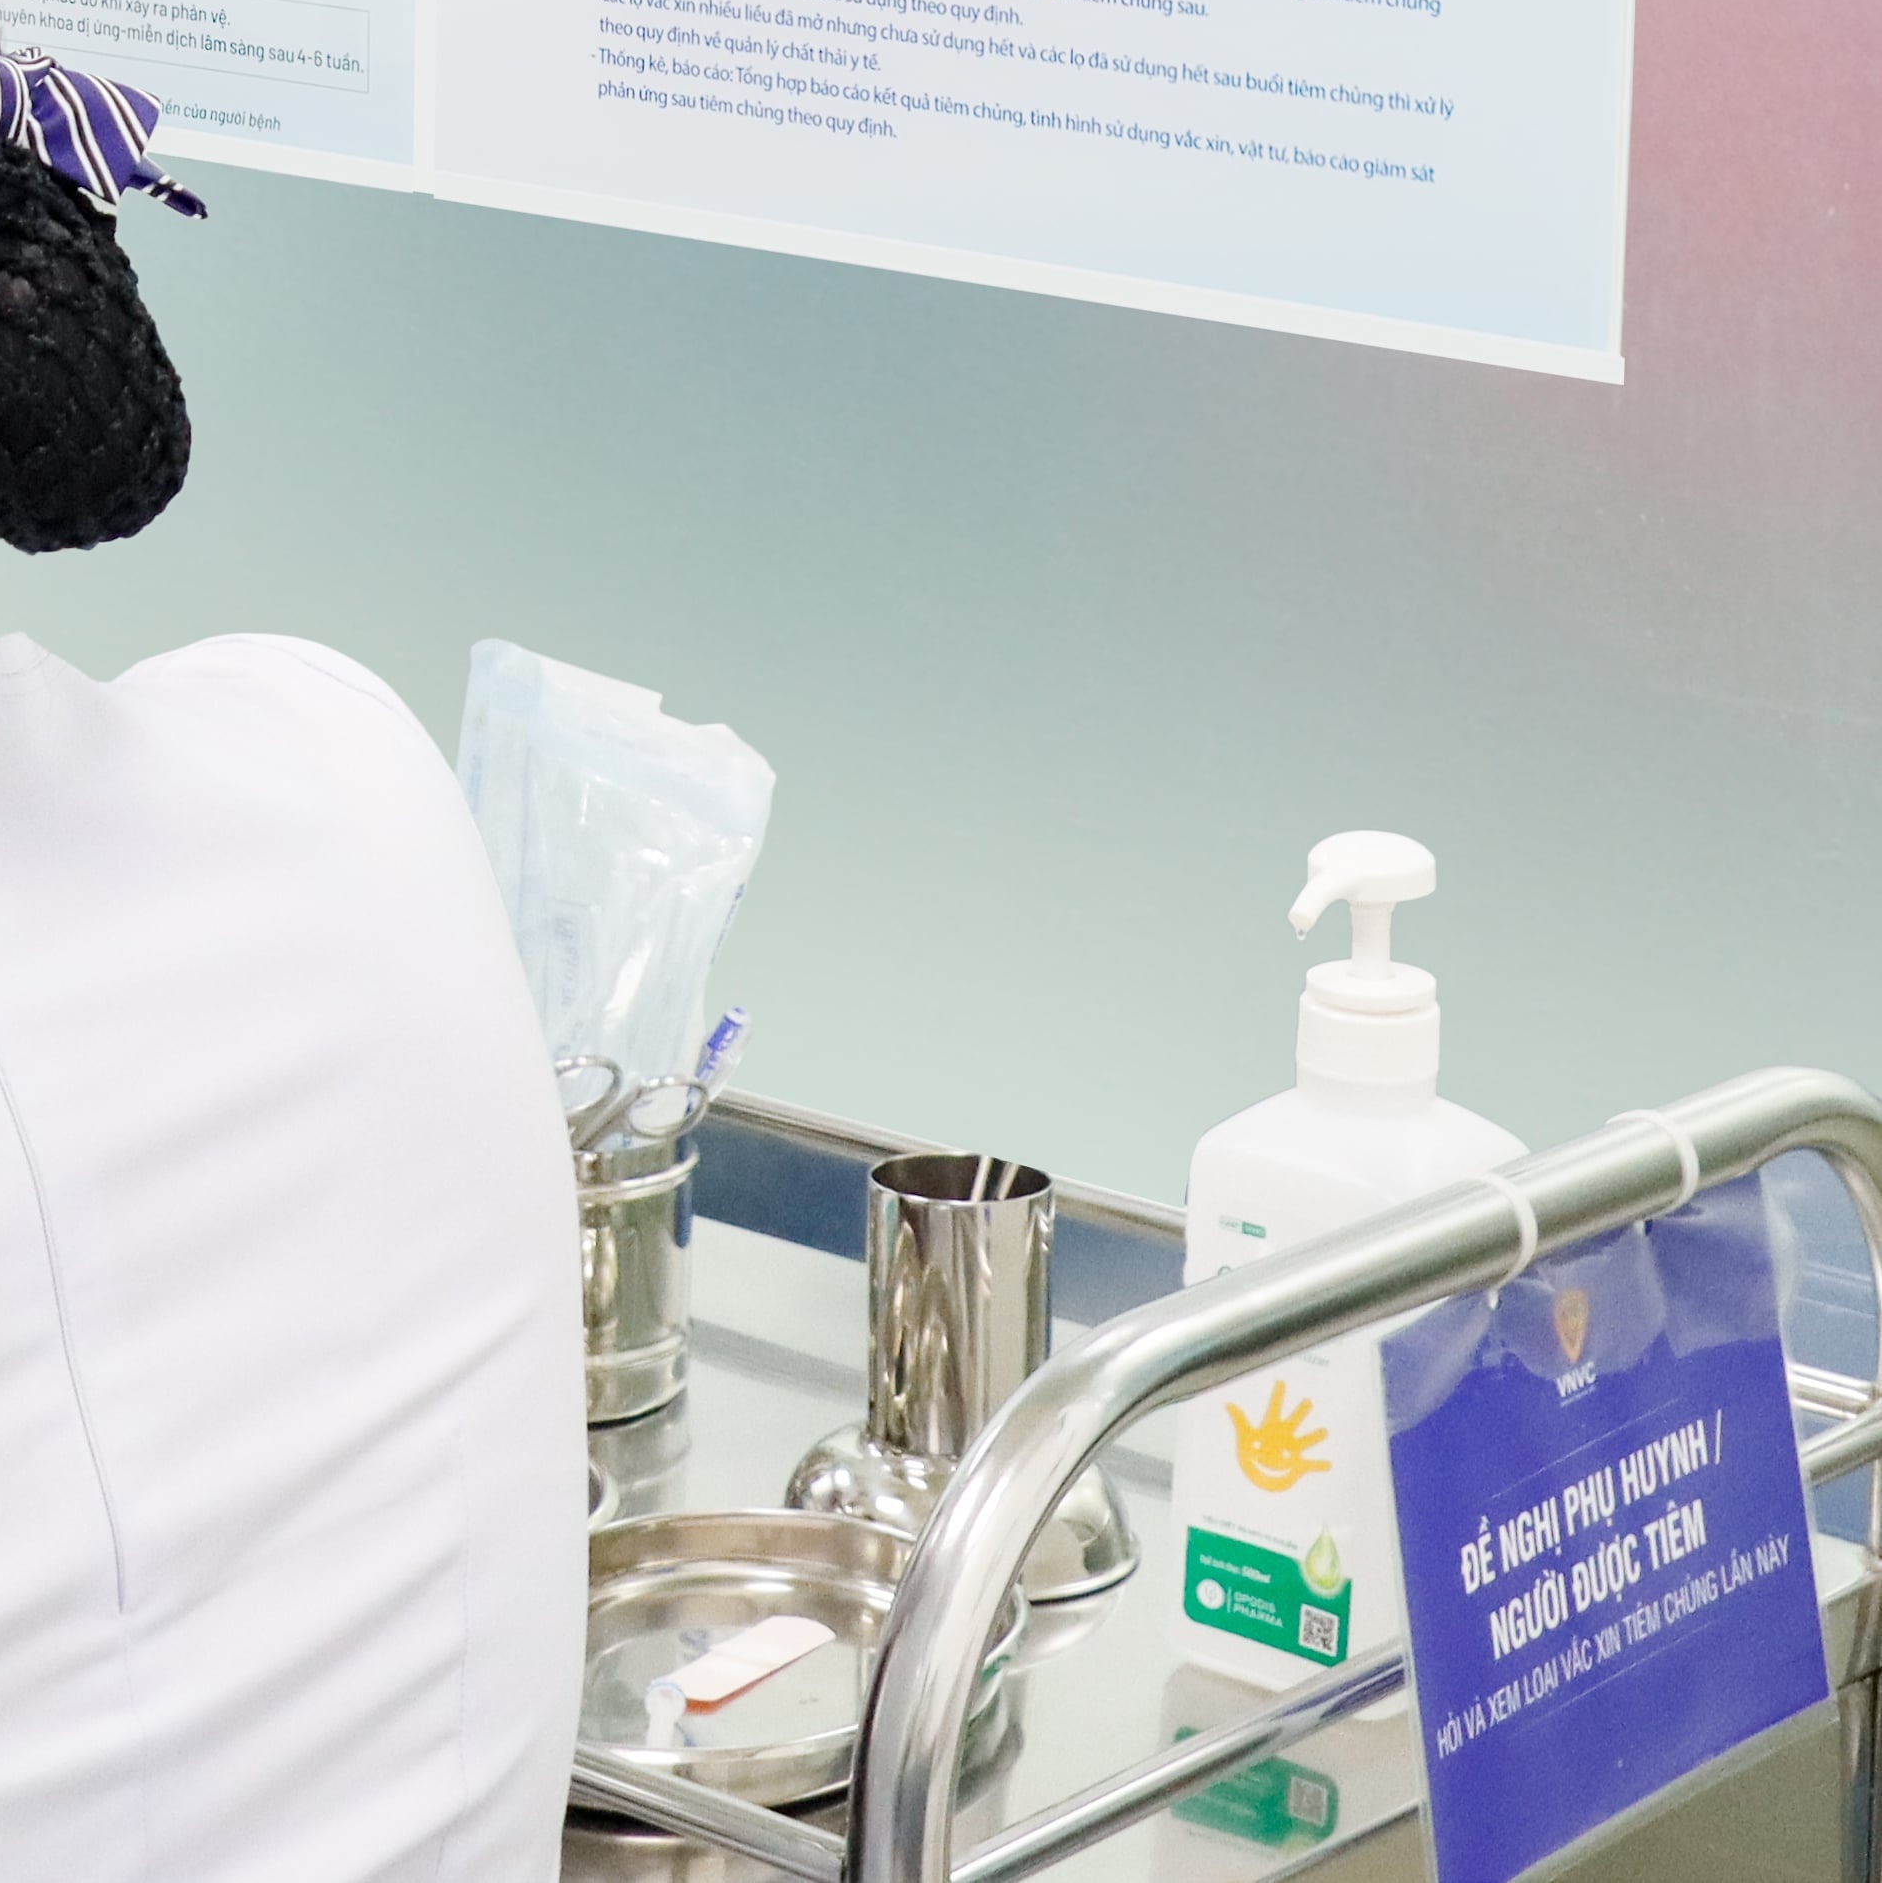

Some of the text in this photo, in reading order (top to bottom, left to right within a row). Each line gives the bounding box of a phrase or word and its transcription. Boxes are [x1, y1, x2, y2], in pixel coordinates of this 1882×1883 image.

[1556, 1361, 1596, 1397] VNVC
[1460, 1515, 1496, 1595] ĐỀ
[1498, 1496, 1563, 1573] NGHỊ
[1563, 1466, 1616, 1537] PHỤ
[1619, 1419, 1708, 1505] HUYNH
[1489, 1499, 1707, 1660] NGƯỜI ĐƯỢC TIÊM
[1436, 1711, 1464, 1759] HỎI
[1463, 1695, 1487, 1740] VÀ
[1487, 1680, 1522, 1728] XEM
[1523, 1657, 1559, 1706] LOẠI
[1594, 1623, 1621, 1664] XIN
[1621, 1601, 1662, 1645] TIÊM
[1663, 1573, 1719, 1625] CHỦNG
[1755, 1533, 1790, 1576] NÀY
